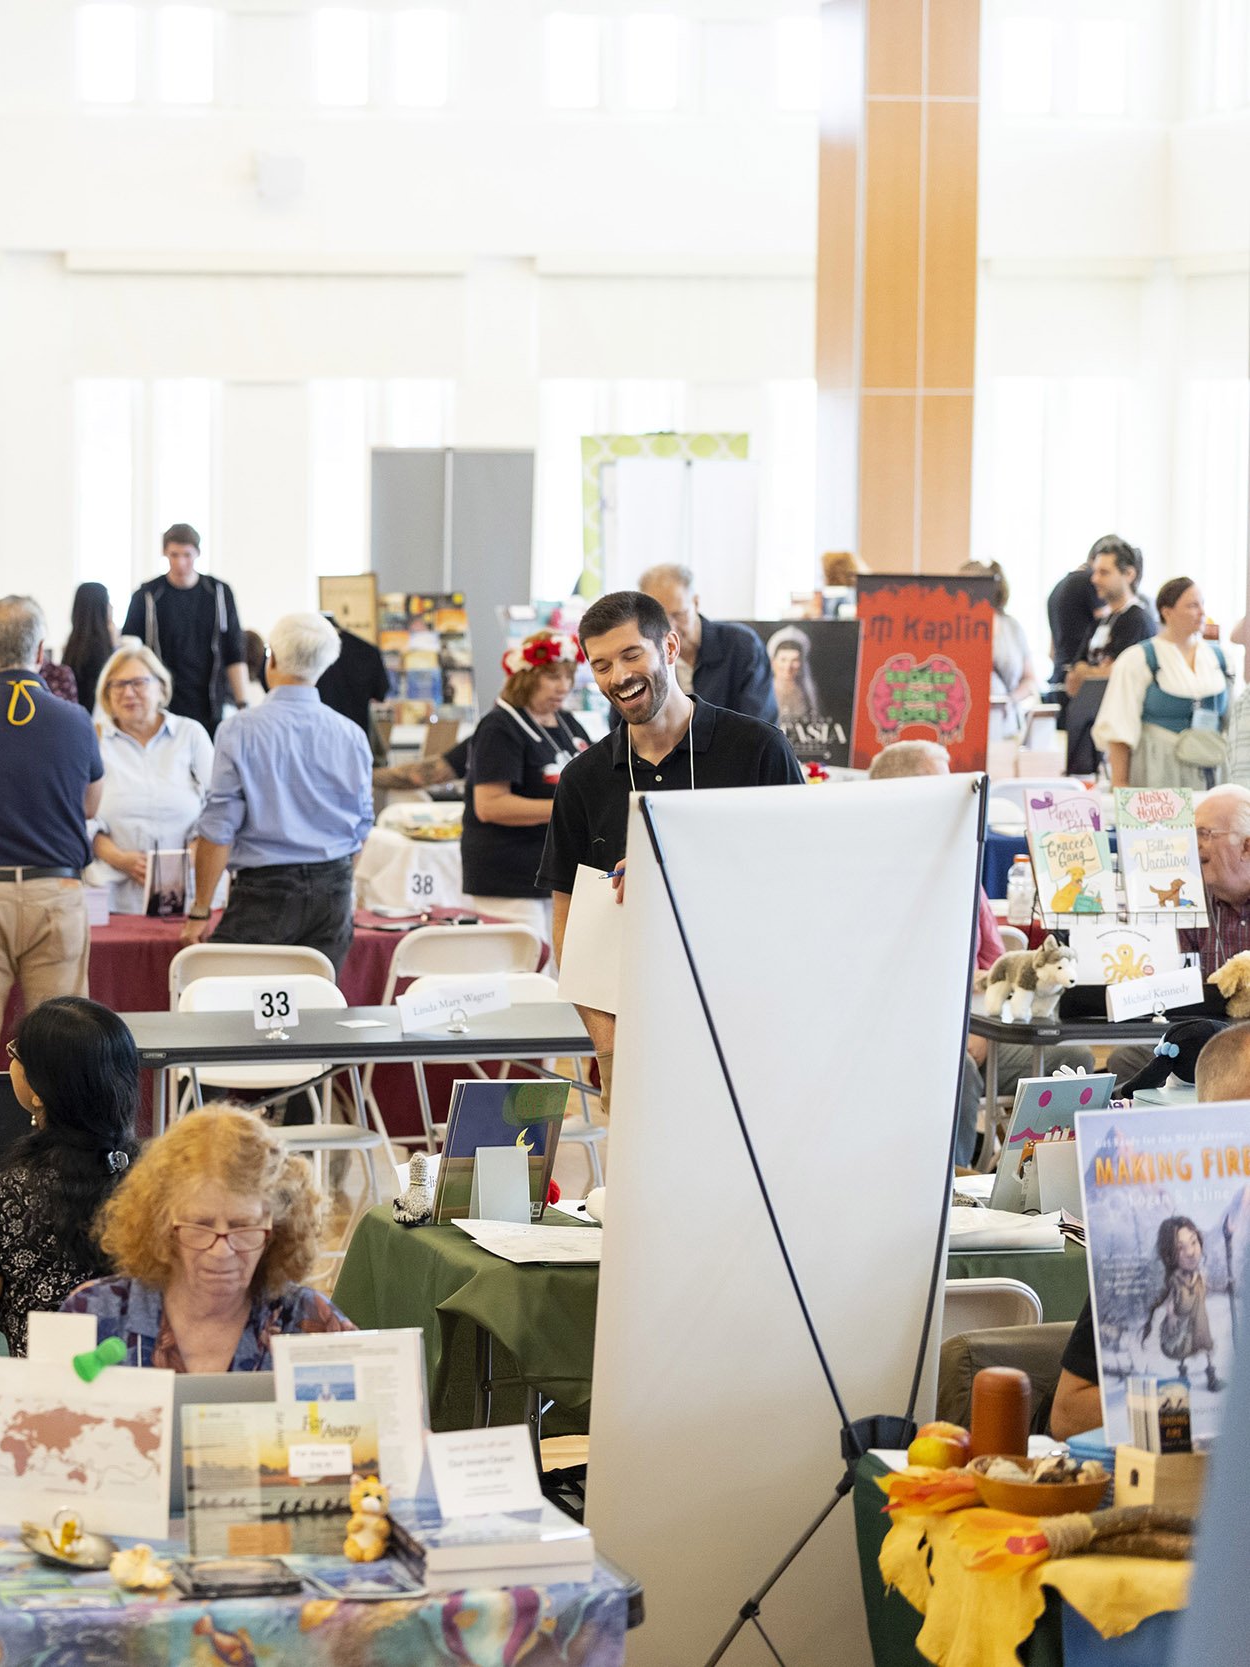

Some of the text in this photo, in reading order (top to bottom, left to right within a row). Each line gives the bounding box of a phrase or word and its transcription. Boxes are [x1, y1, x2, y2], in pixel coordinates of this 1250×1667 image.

[903, 613, 990, 649] Kaplin
[1138, 790, 1173, 806] Husky
[1137, 805, 1175, 824] Holiday
[1058, 852, 1095, 869] Gang
[1135, 852, 1190, 872] Vacation
[412, 873, 433, 895] 38
[260, 990, 290, 1018] 33
[413, 989, 496, 1016] Linda Mary Wagner
[1123, 982, 1190, 1005] Michael Kennedy
[1095, 1146, 1250, 1188] MAKING FIRE
